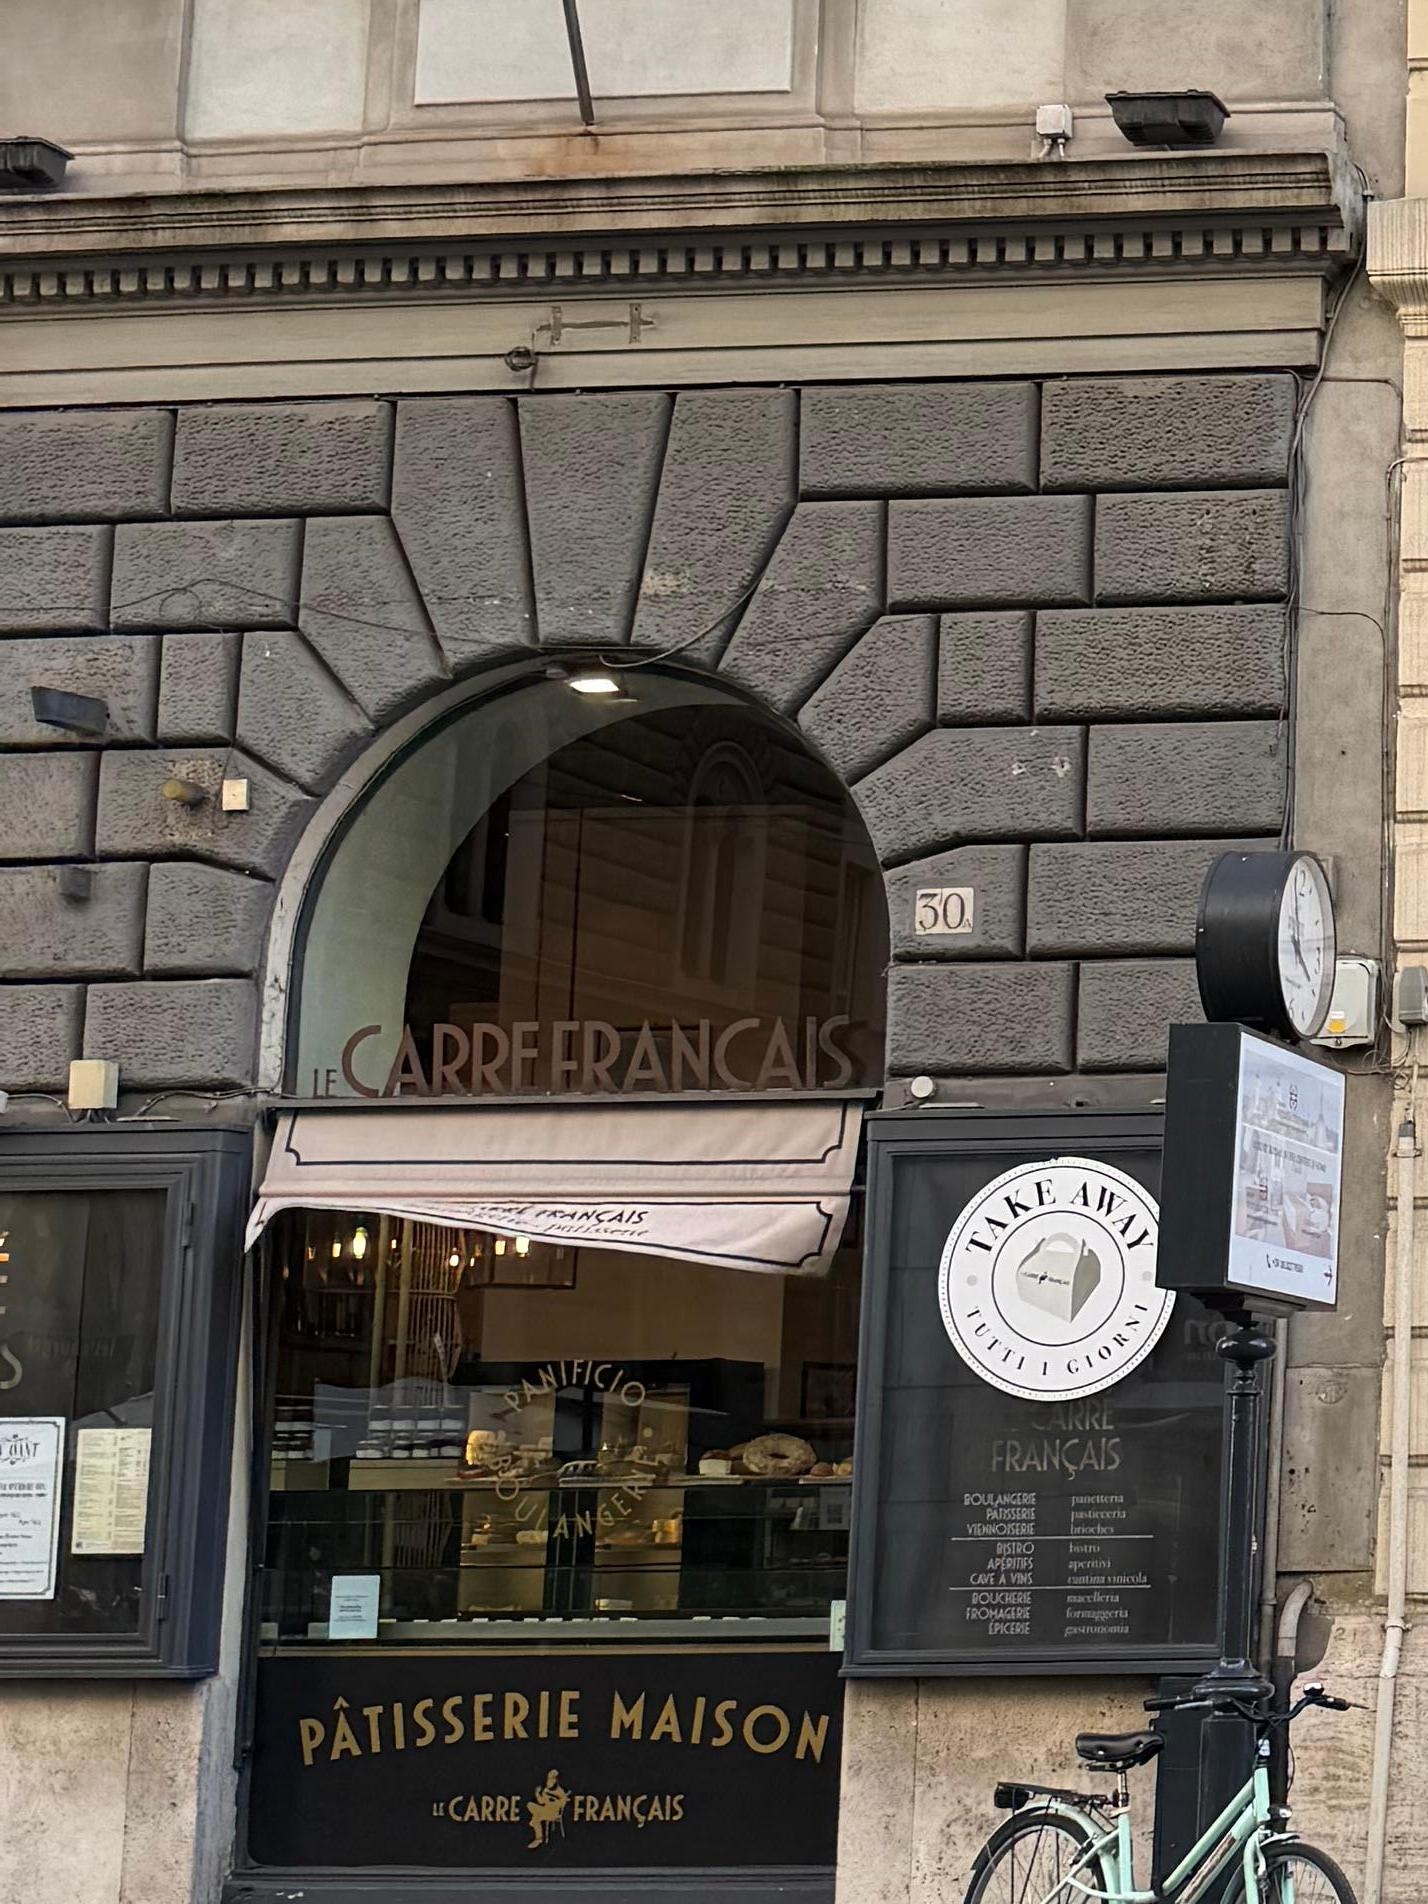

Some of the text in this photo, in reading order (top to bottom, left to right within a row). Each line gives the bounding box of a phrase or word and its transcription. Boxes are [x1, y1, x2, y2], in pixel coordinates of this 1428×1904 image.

[313, 1068, 338, 1097] LE
[341, 1020, 539, 1097] CARRE
[965, 1178, 1154, 1255] TAKE AWAY
[965, 1305, 1026, 1371] TUTTI
[1041, 1361, 1048, 1376] I
[1066, 1303, 1148, 1375] GIORNI
[504, 1359, 646, 1412] PANIFICIO
[991, 1437, 1121, 1481] FRANÇAIS
[964, 1492, 1036, 1506] BOULANGERIE
[966, 1523, 1036, 1536] VIENNOISERIE
[996, 1542, 1035, 1555] BISTRO
[970, 1572, 995, 1585] CAVE
[1010, 1572, 1033, 1585] VINS
[971, 1591, 1032, 1605] BOUCHERIE
[1066, 1591, 1120, 1603] macelleria
[966, 1607, 1032, 1620] FROMAGERIE
[1066, 1607, 1129, 1622] formaggeria
[1064, 1623, 1130, 1637] gastronomia
[299, 1689, 830, 1766] PÂTISSERIE MAISON
[432, 1802, 445, 1817] LE
[573, 1793, 684, 1828] FRANÇAIS
